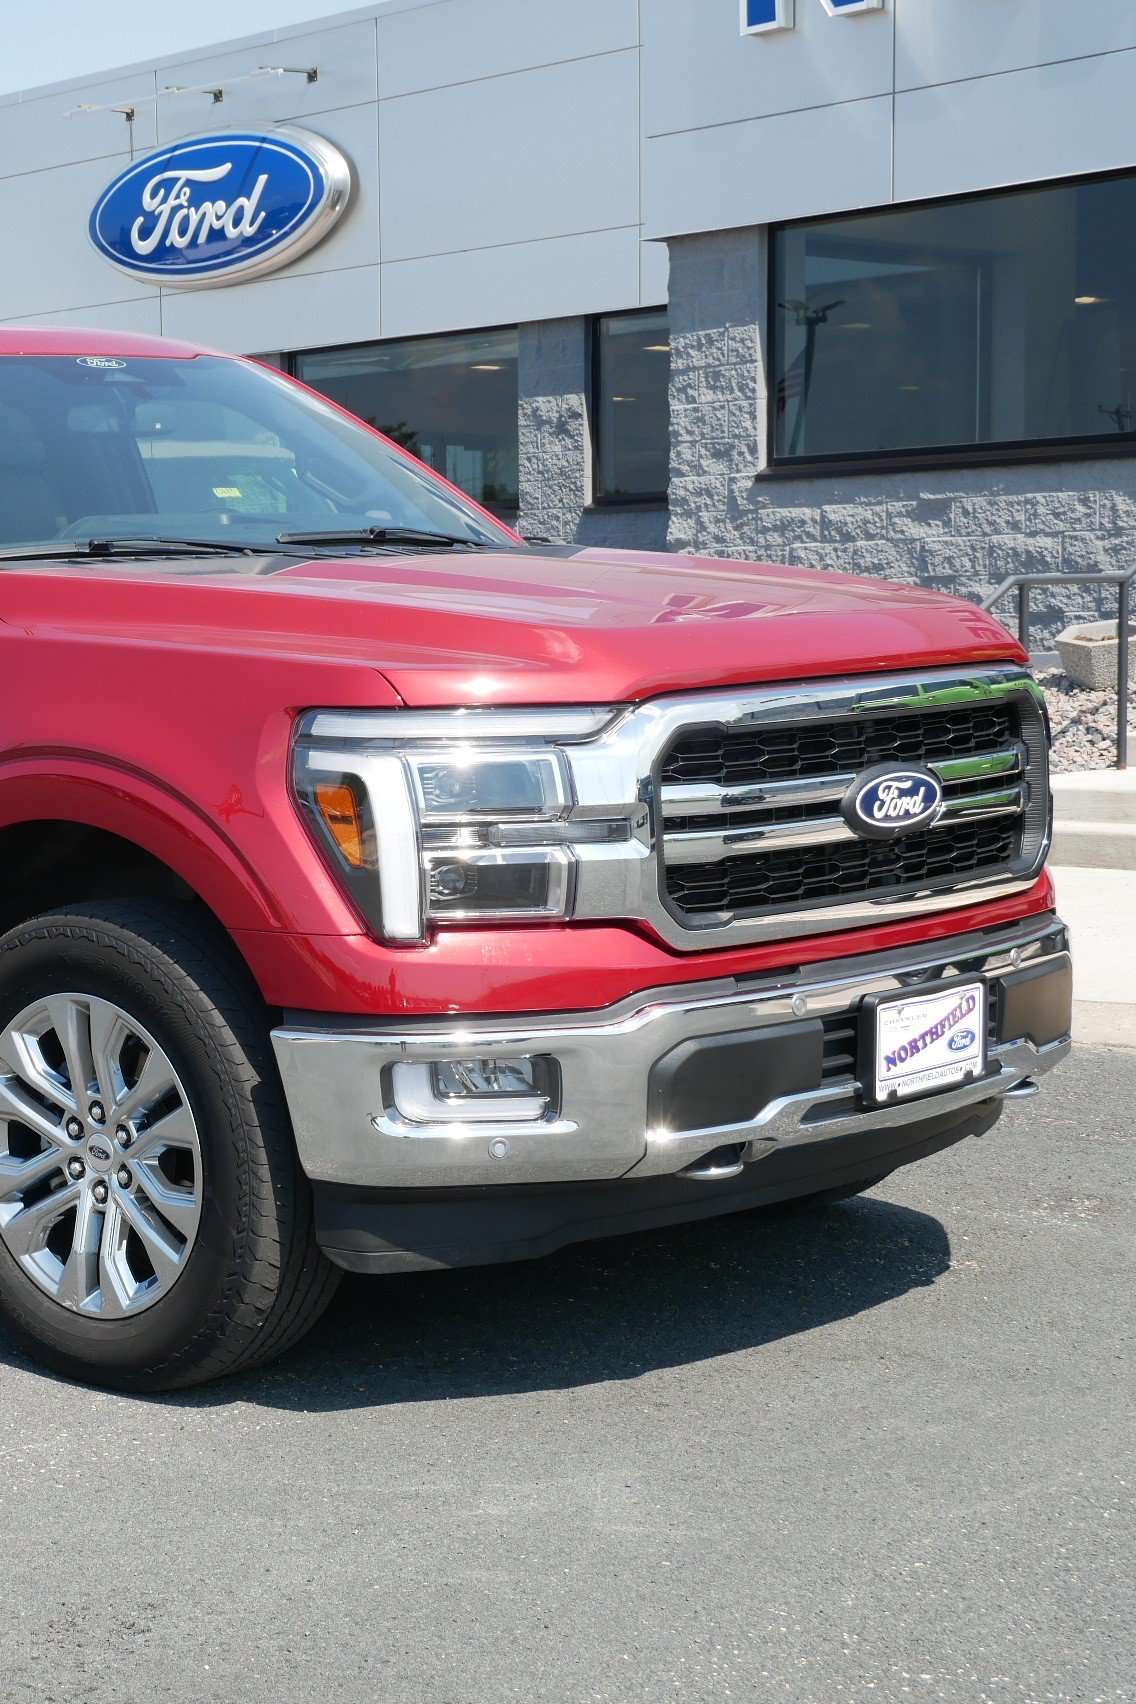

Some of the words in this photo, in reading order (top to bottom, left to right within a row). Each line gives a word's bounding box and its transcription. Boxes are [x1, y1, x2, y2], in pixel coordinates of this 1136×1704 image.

[130, 162, 269, 255] Ford
[873, 780, 926, 819] Ford
[883, 994, 976, 1072] NORTHFIELD
[951, 1031, 971, 1049] Ford
